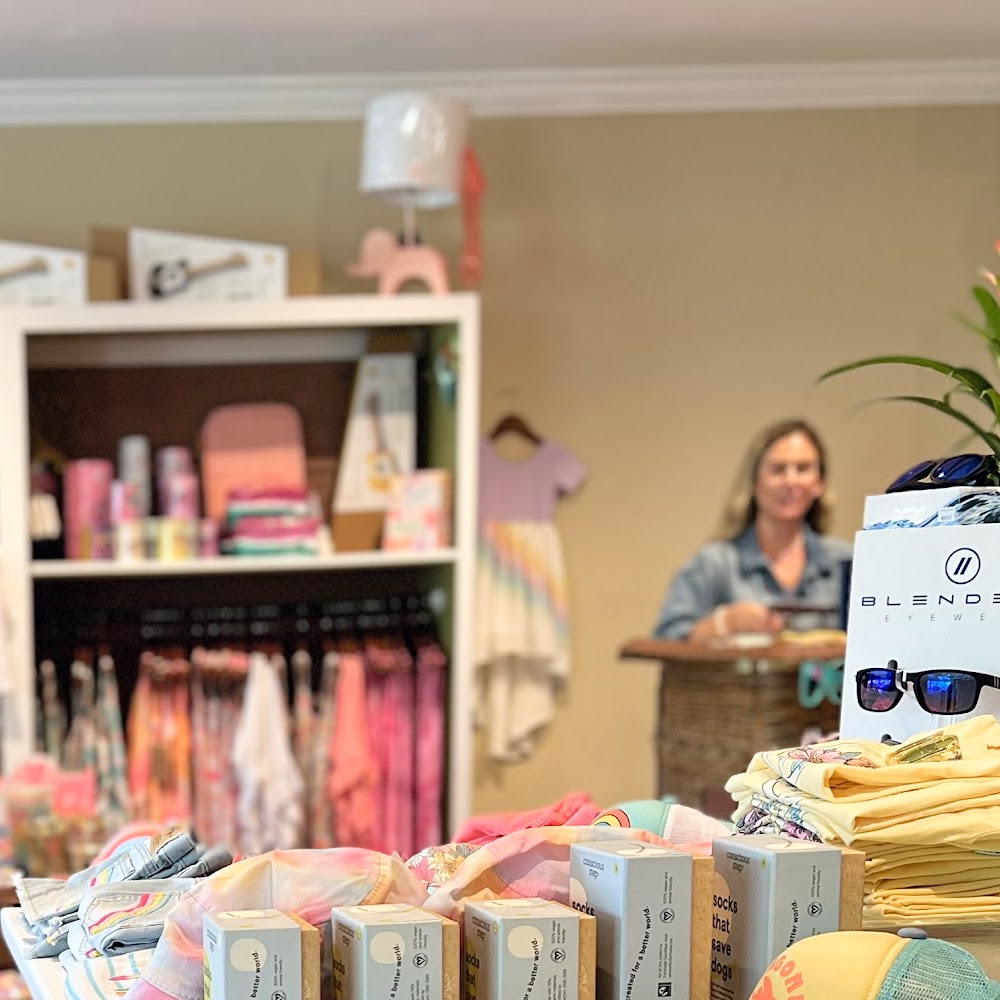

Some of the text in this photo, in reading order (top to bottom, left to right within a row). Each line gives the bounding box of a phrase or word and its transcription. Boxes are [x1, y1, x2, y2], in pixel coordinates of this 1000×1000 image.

[572, 901, 595, 916] socks
[713, 894, 738, 914] socks
[643, 906, 651, 929] world.
[712, 914, 730, 934] that
[531, 938, 540, 961] world.
[639, 932, 650, 955] better
[712, 938, 732, 956] save
[529, 963, 538, 986] better
[632, 962, 640, 973] for
[711, 957, 733, 981] dogs
[250, 974, 260, 998] better
[391, 968, 401, 992] better
